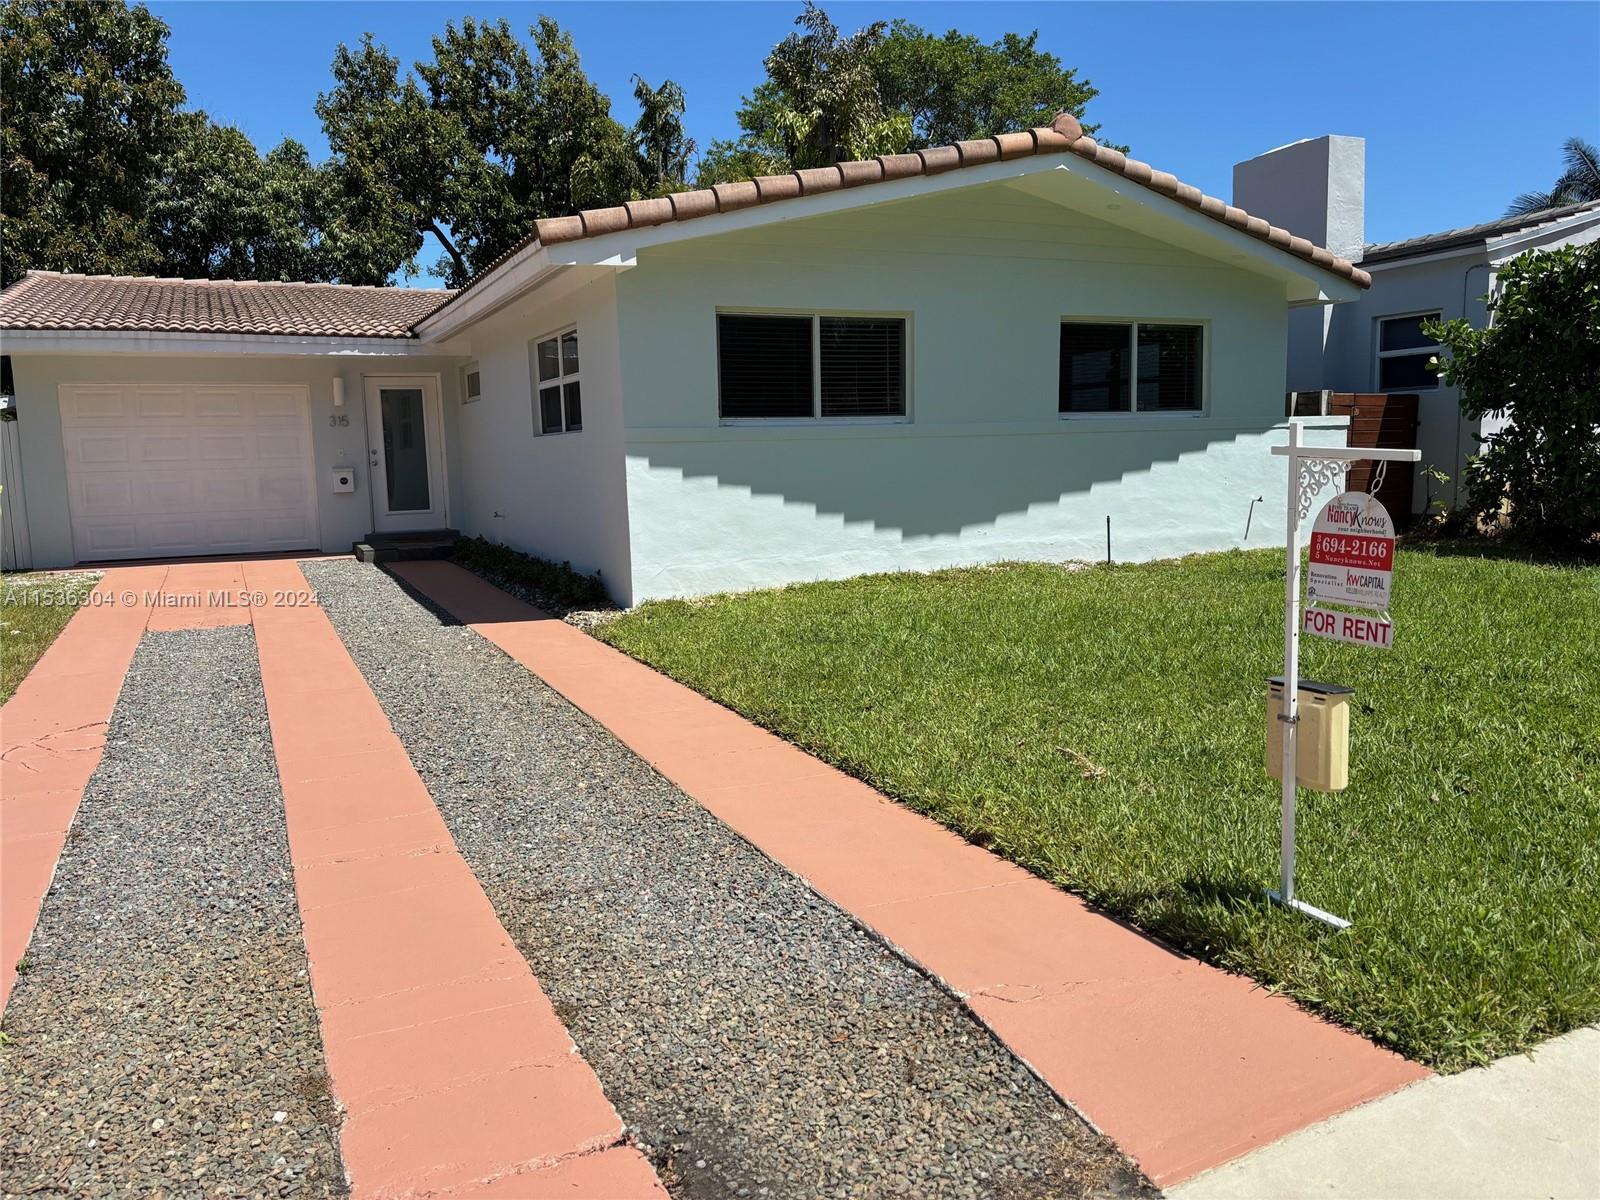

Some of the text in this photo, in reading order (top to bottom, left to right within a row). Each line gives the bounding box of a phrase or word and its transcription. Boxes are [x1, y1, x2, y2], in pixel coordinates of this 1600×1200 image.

[329, 415, 350, 428] 315
[1322, 537, 1387, 558] 694-2166
[1310, 571, 1337, 580] Renovation
[1304, 610, 1391, 644] FOR RENT
